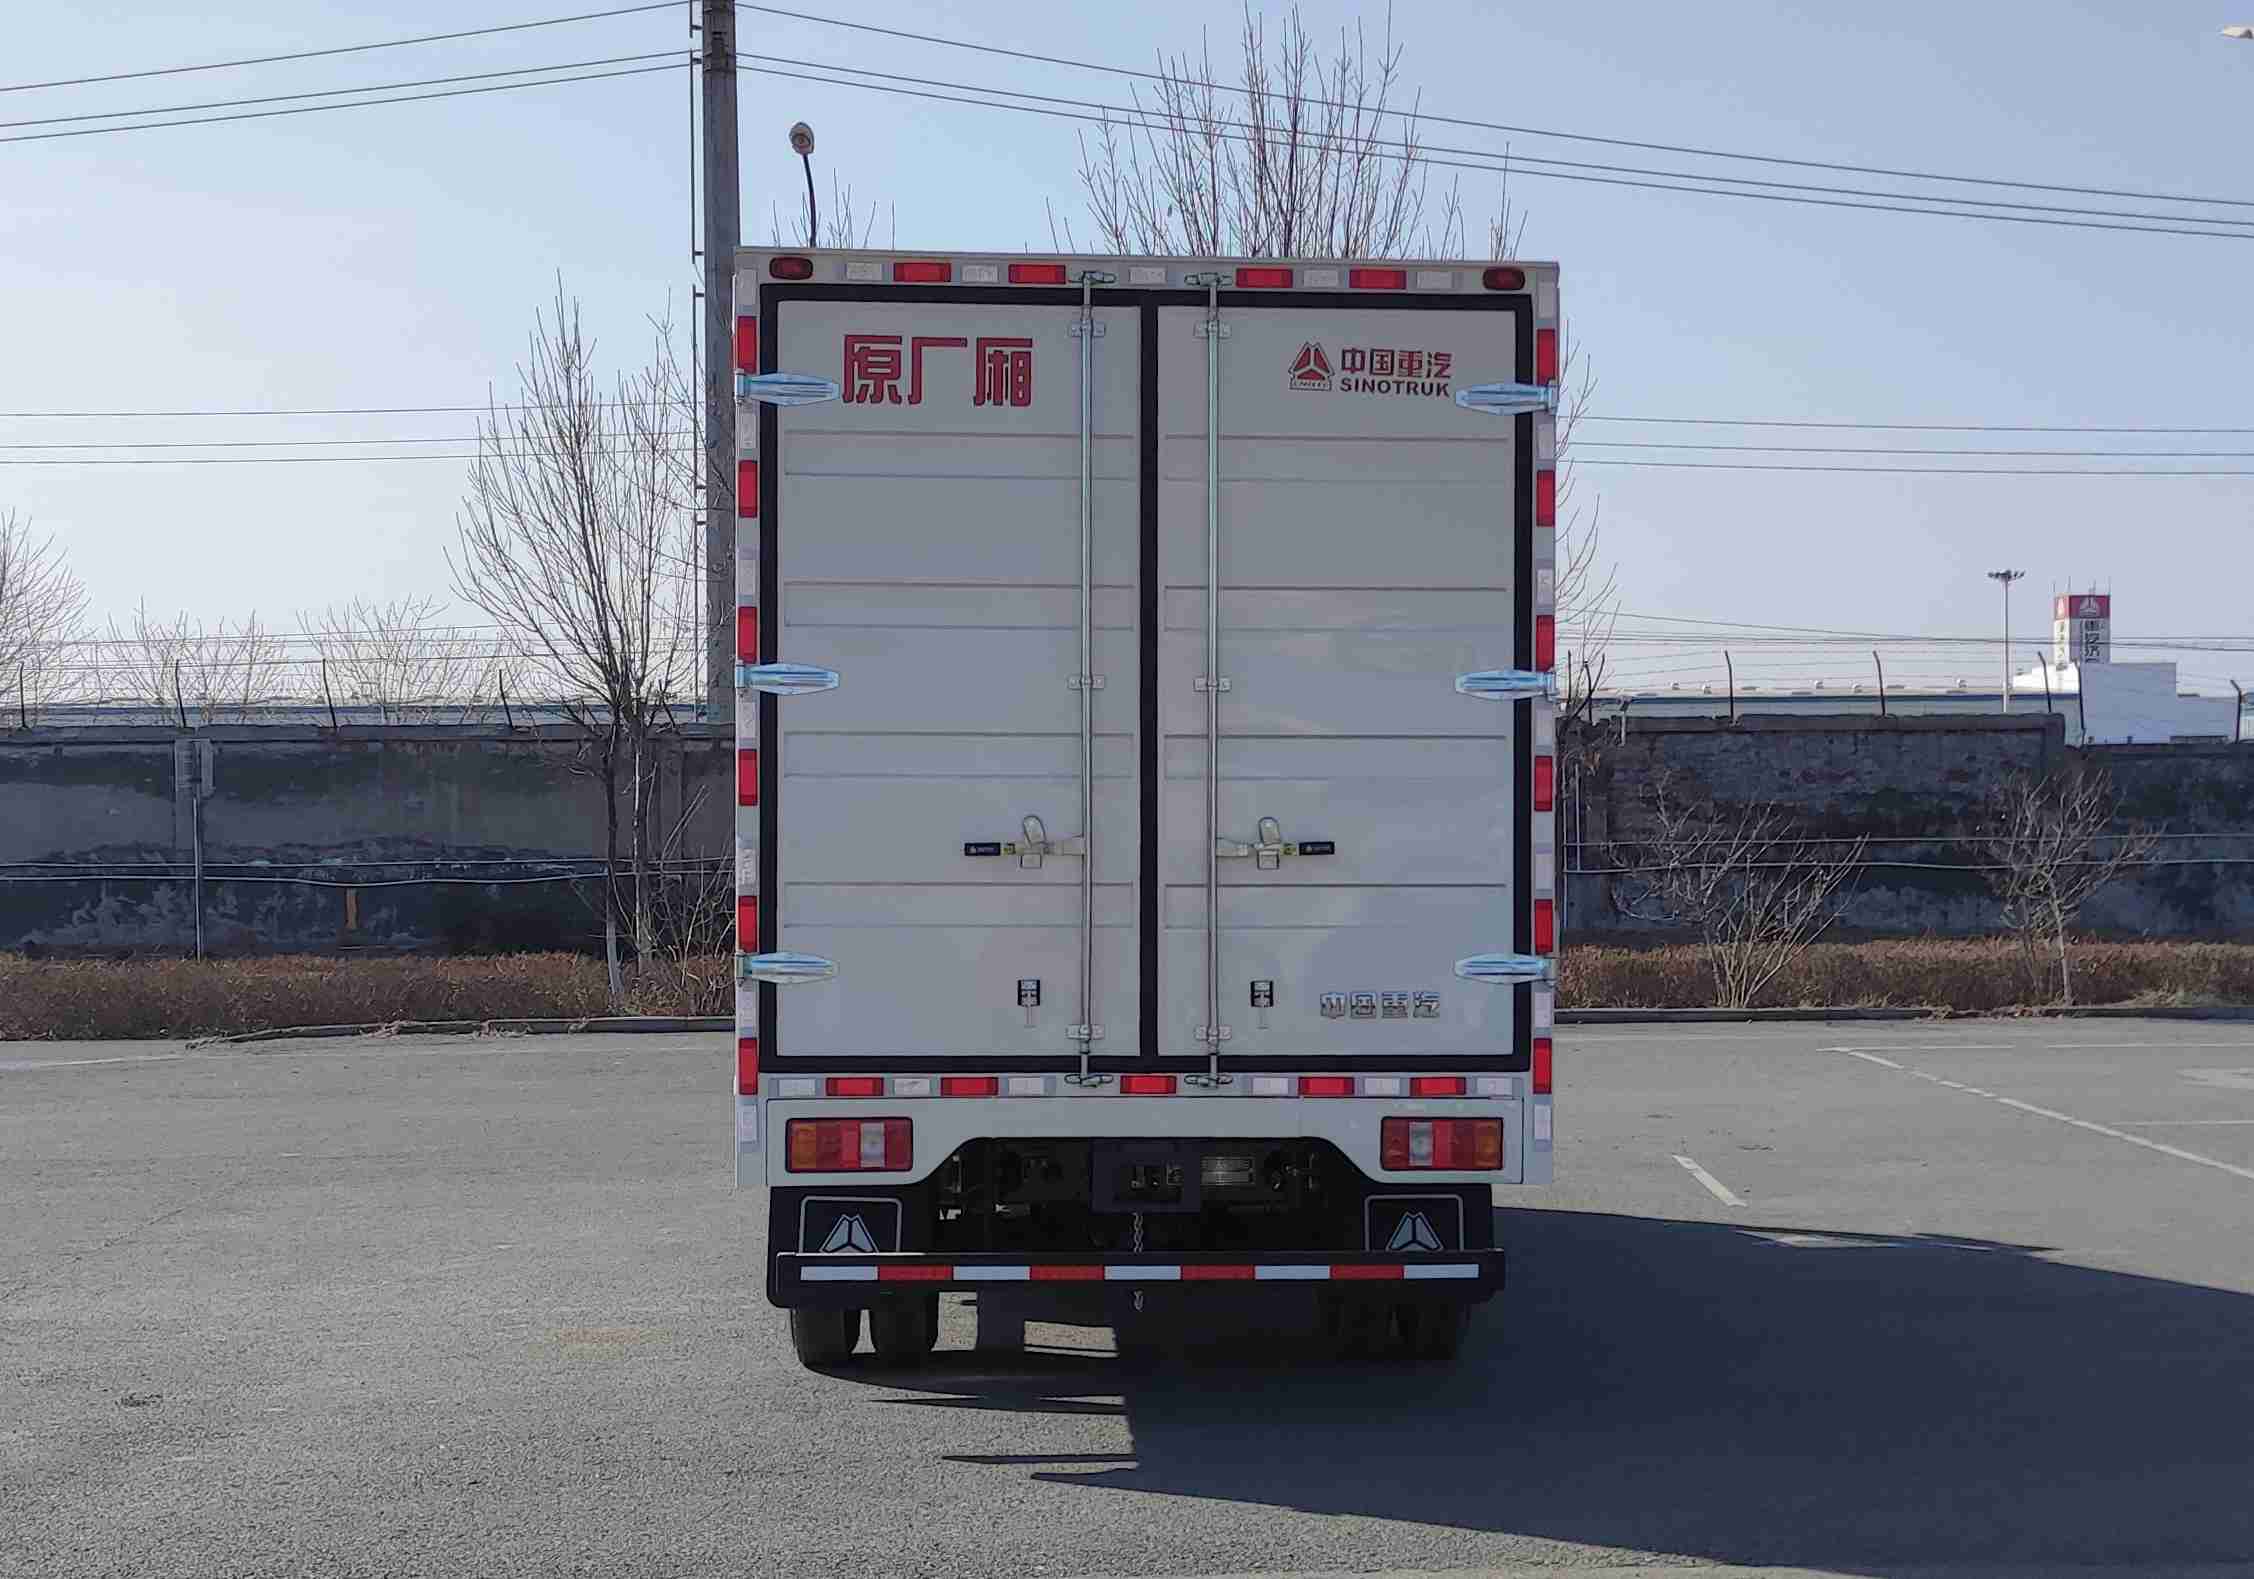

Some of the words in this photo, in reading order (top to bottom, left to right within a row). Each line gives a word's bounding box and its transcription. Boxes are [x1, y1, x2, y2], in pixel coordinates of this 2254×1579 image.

[842, 335, 1033, 406] 原厂厢
[1341, 348, 1452, 378] 中国重汽
[1340, 378, 1449, 397] SINOTRUK
